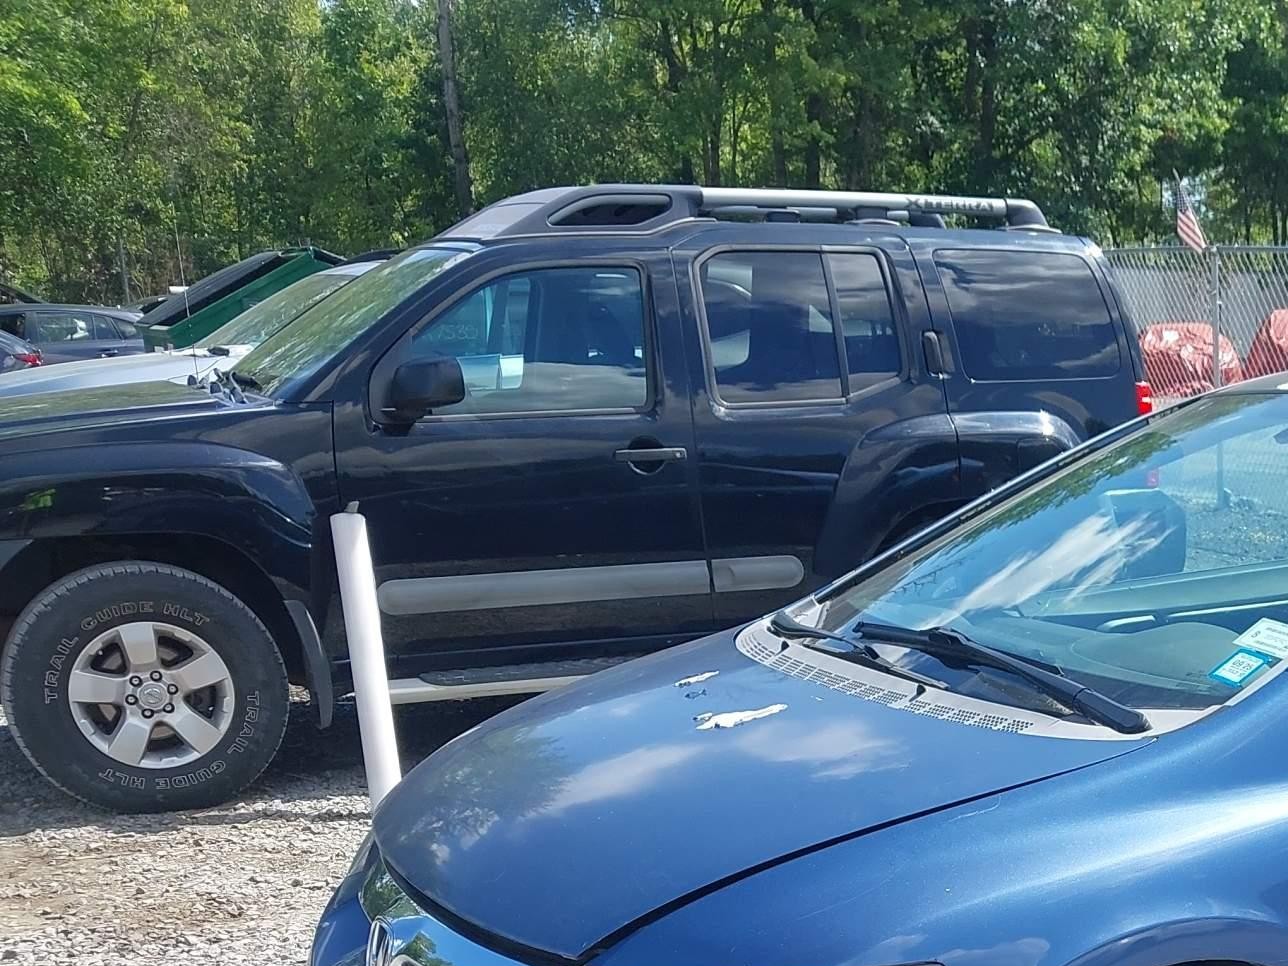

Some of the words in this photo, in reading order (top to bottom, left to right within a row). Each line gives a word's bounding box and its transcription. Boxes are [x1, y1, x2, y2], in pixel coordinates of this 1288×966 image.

[45, 636, 79, 704] TRAIL
[80, 601, 154, 631] GUIDE
[162, 602, 209, 626] HLT
[227, 690, 260, 755] TRAIL
[99, 768, 145, 790] HLT
[155, 760, 226, 790] GUIDE
